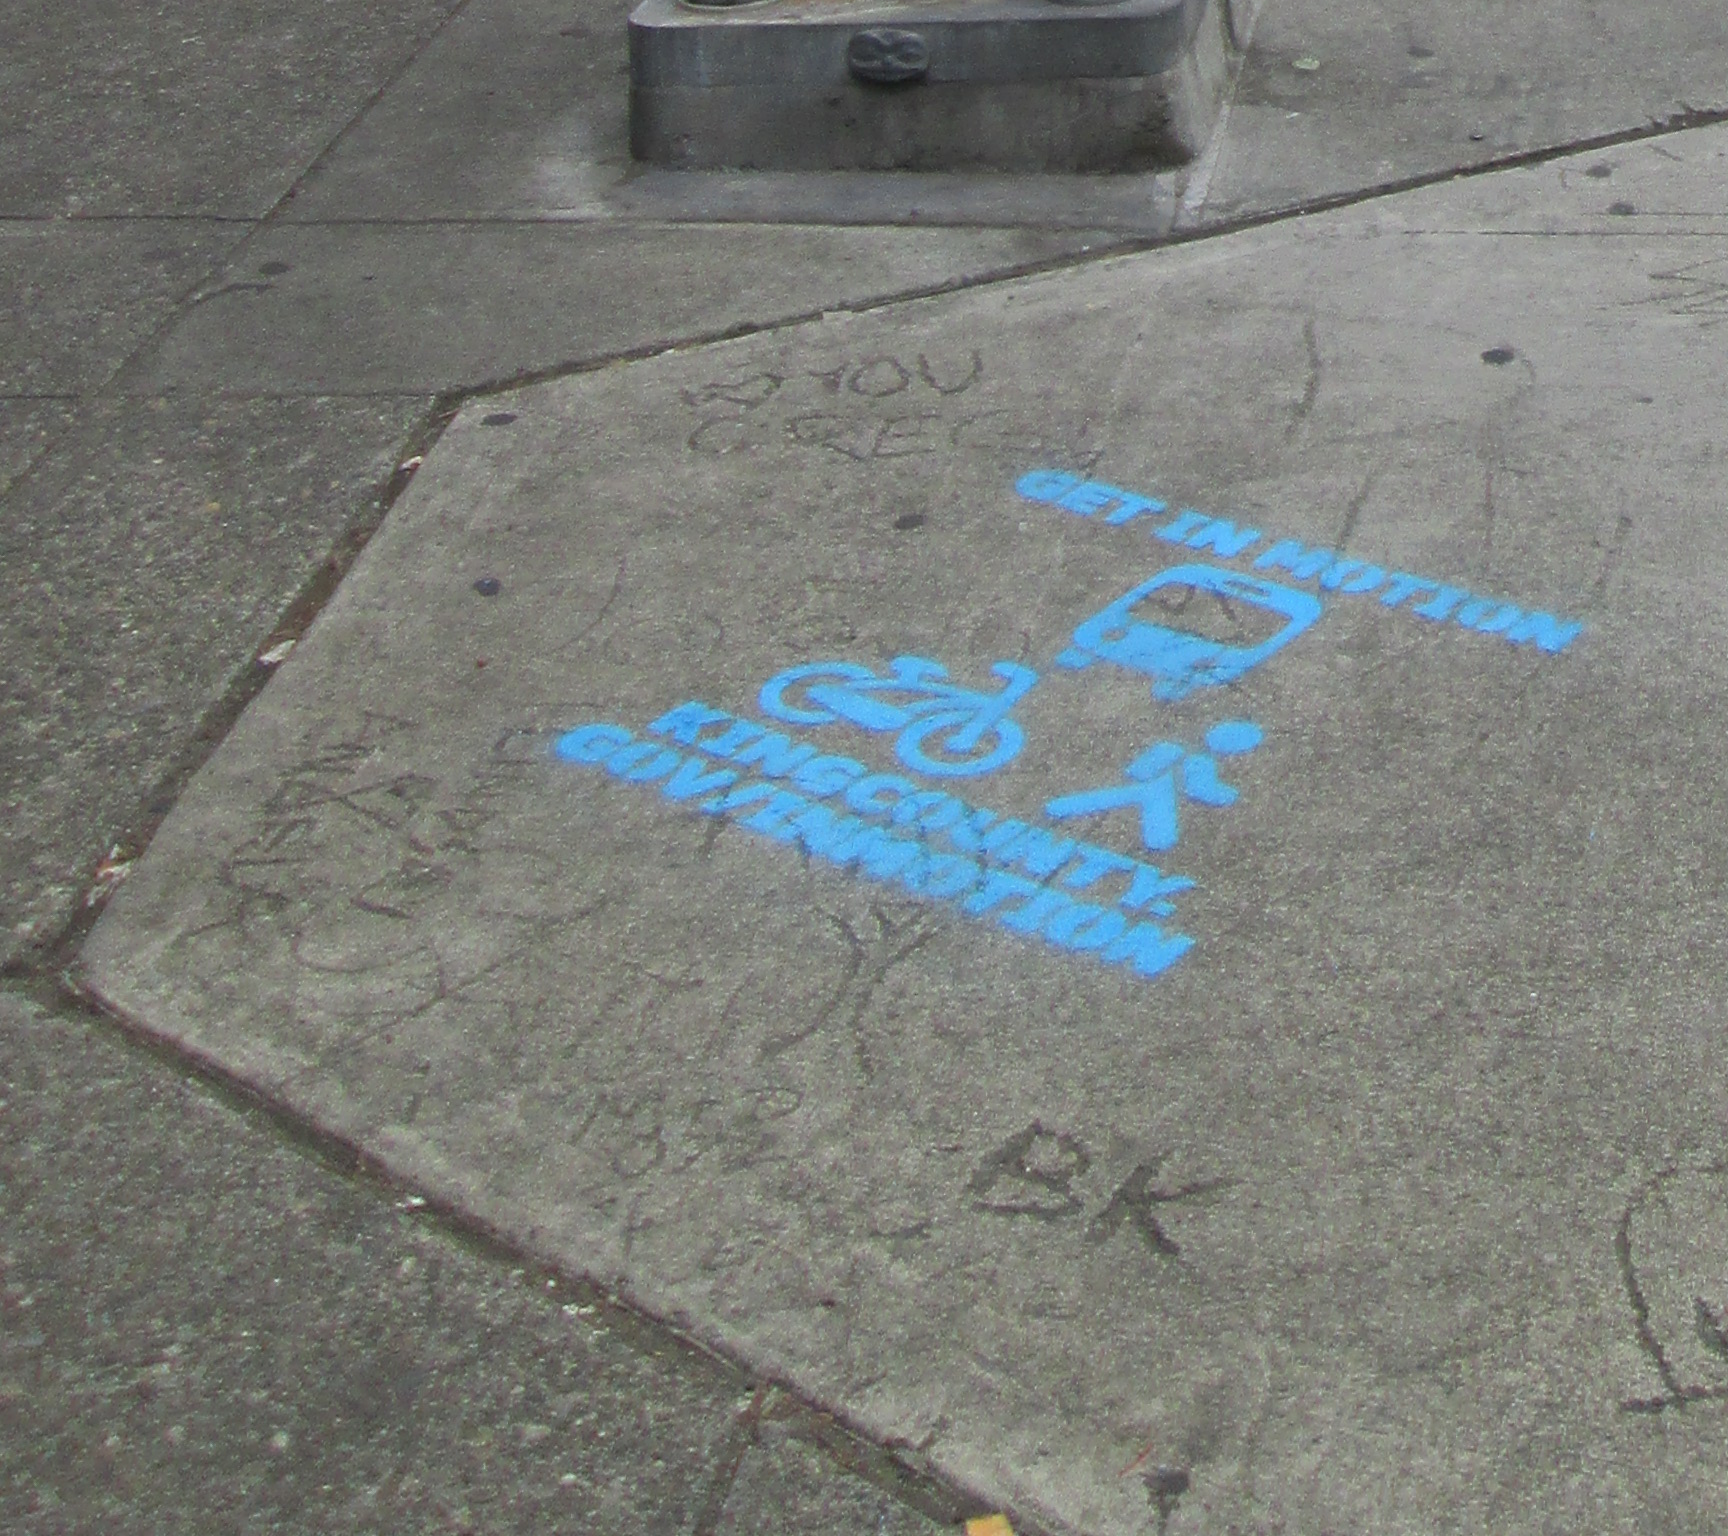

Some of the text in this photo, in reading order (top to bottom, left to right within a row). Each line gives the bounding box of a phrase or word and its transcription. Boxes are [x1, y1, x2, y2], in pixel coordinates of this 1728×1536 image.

[1013, 469, 1584, 655] GET IN MOTION
